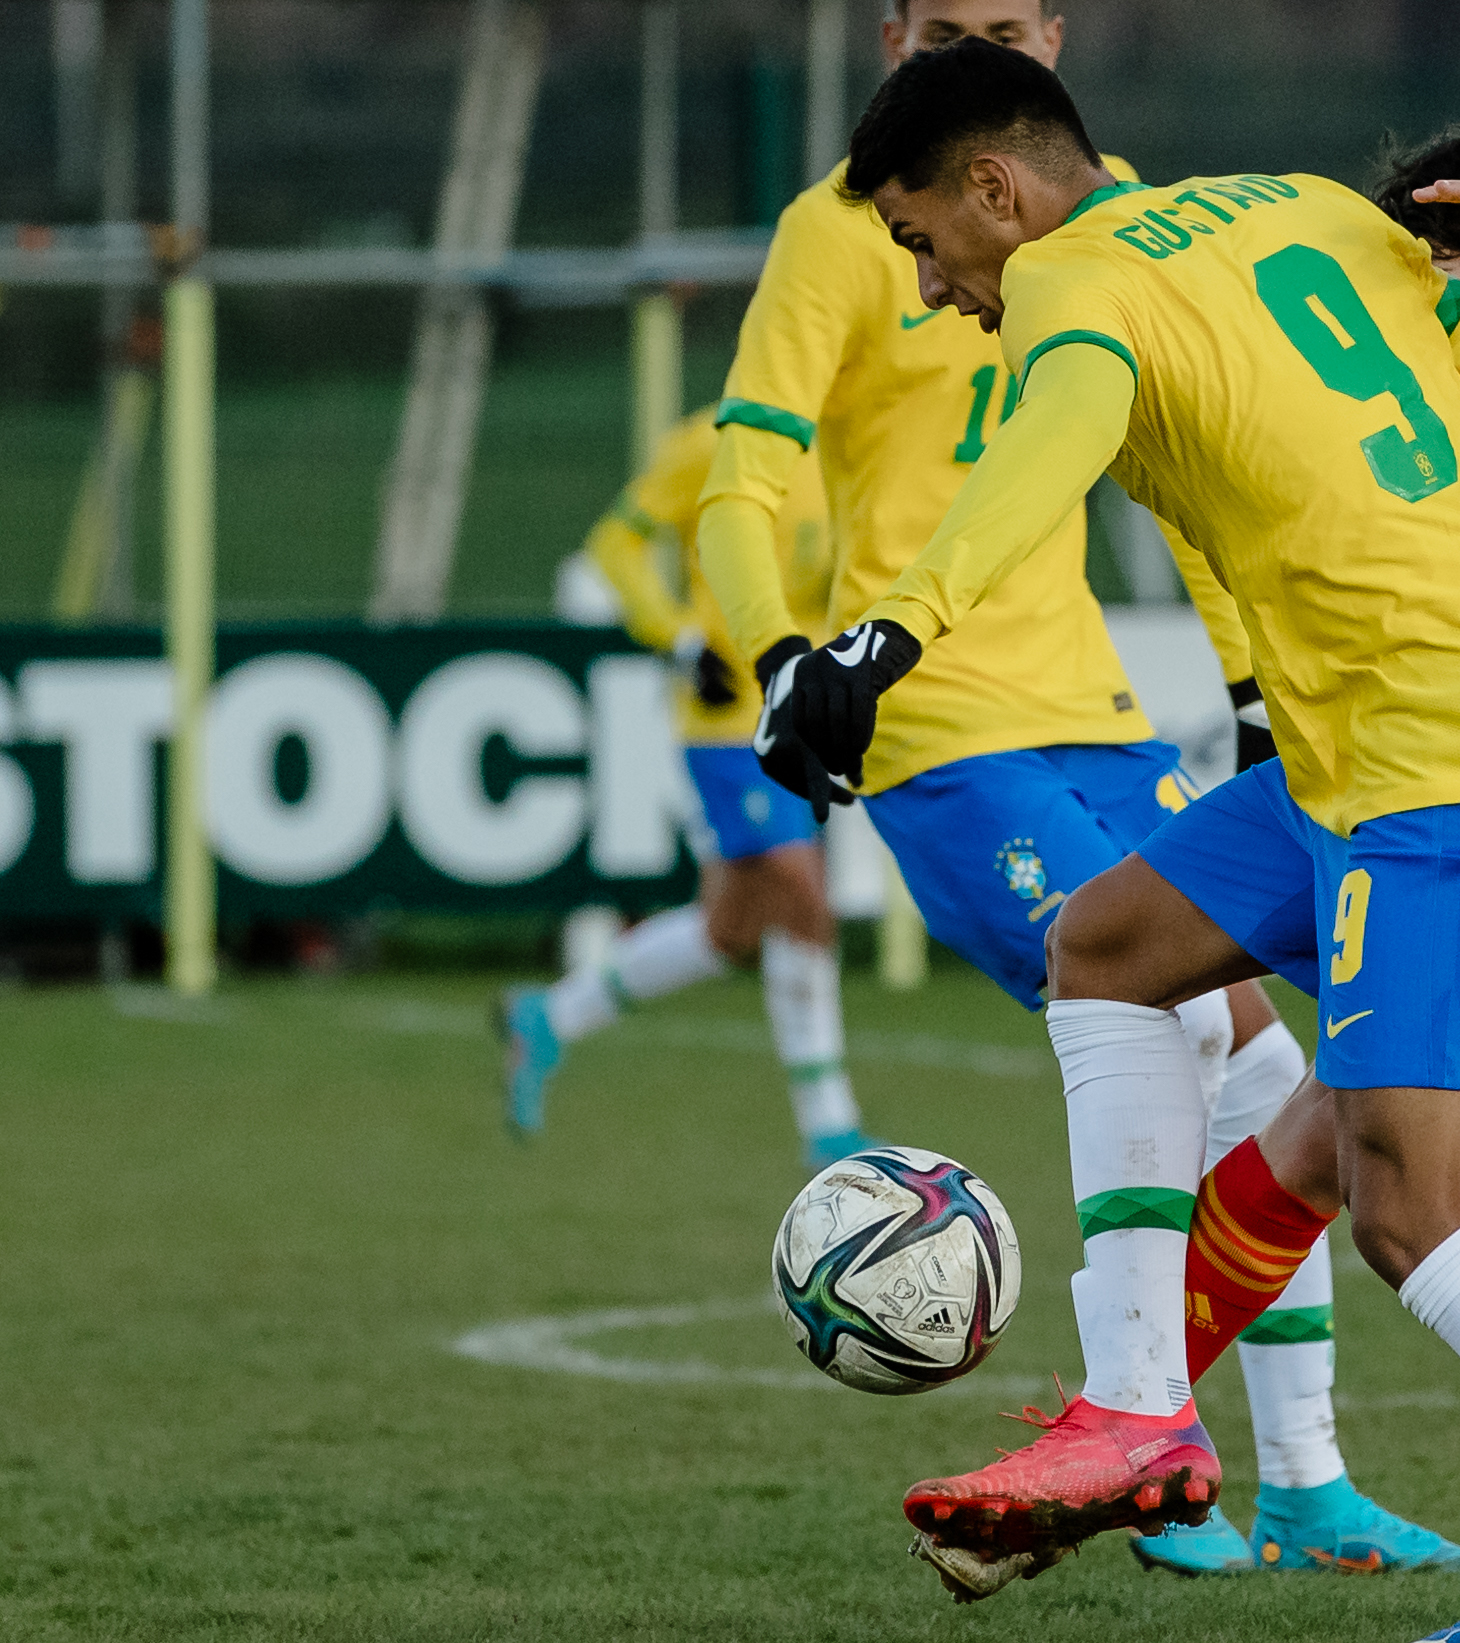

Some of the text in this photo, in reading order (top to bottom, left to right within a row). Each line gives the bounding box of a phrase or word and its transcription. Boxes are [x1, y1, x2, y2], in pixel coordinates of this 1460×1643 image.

[1253, 243, 1458, 503] 9
[1331, 868, 1371, 985] 9
[917, 1320, 956, 1334] adidas
